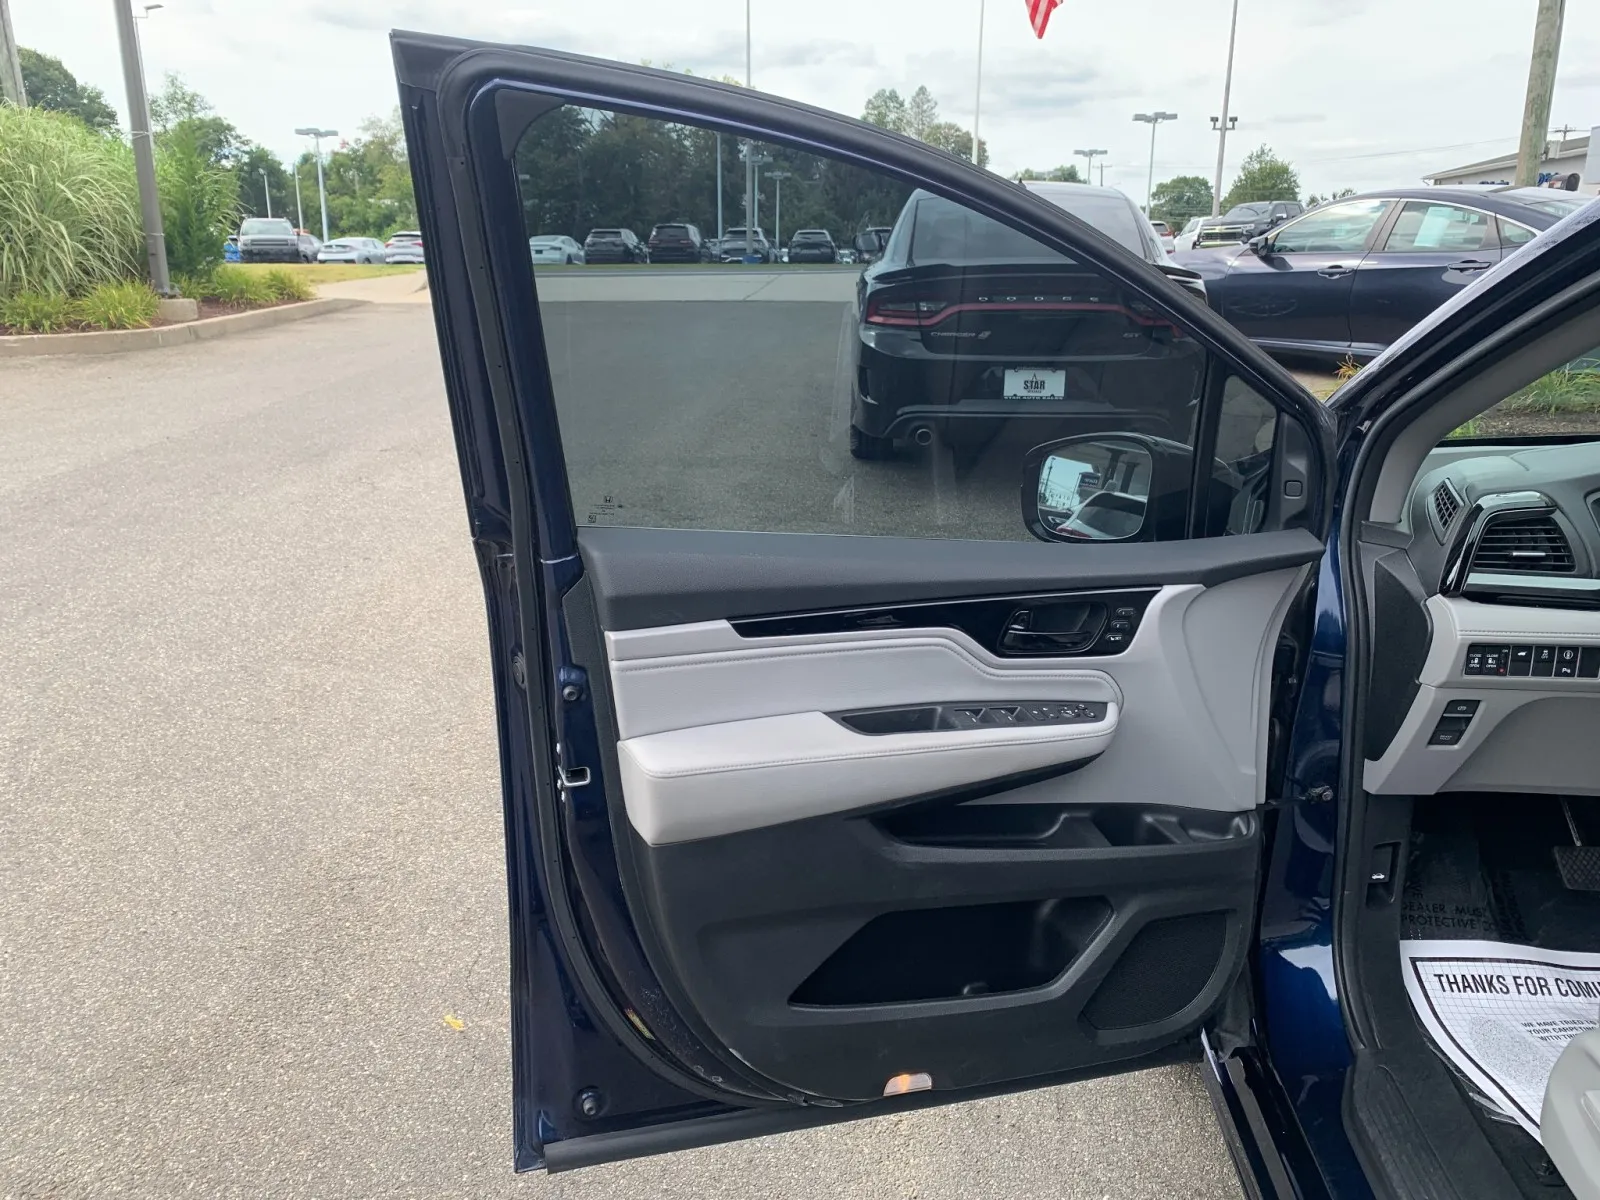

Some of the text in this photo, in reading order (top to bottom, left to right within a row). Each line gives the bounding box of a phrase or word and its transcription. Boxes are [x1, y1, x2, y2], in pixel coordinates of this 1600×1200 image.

[1023, 380, 1046, 390] STAR
[1433, 973, 1600, 999] THANKS FOR COMI
